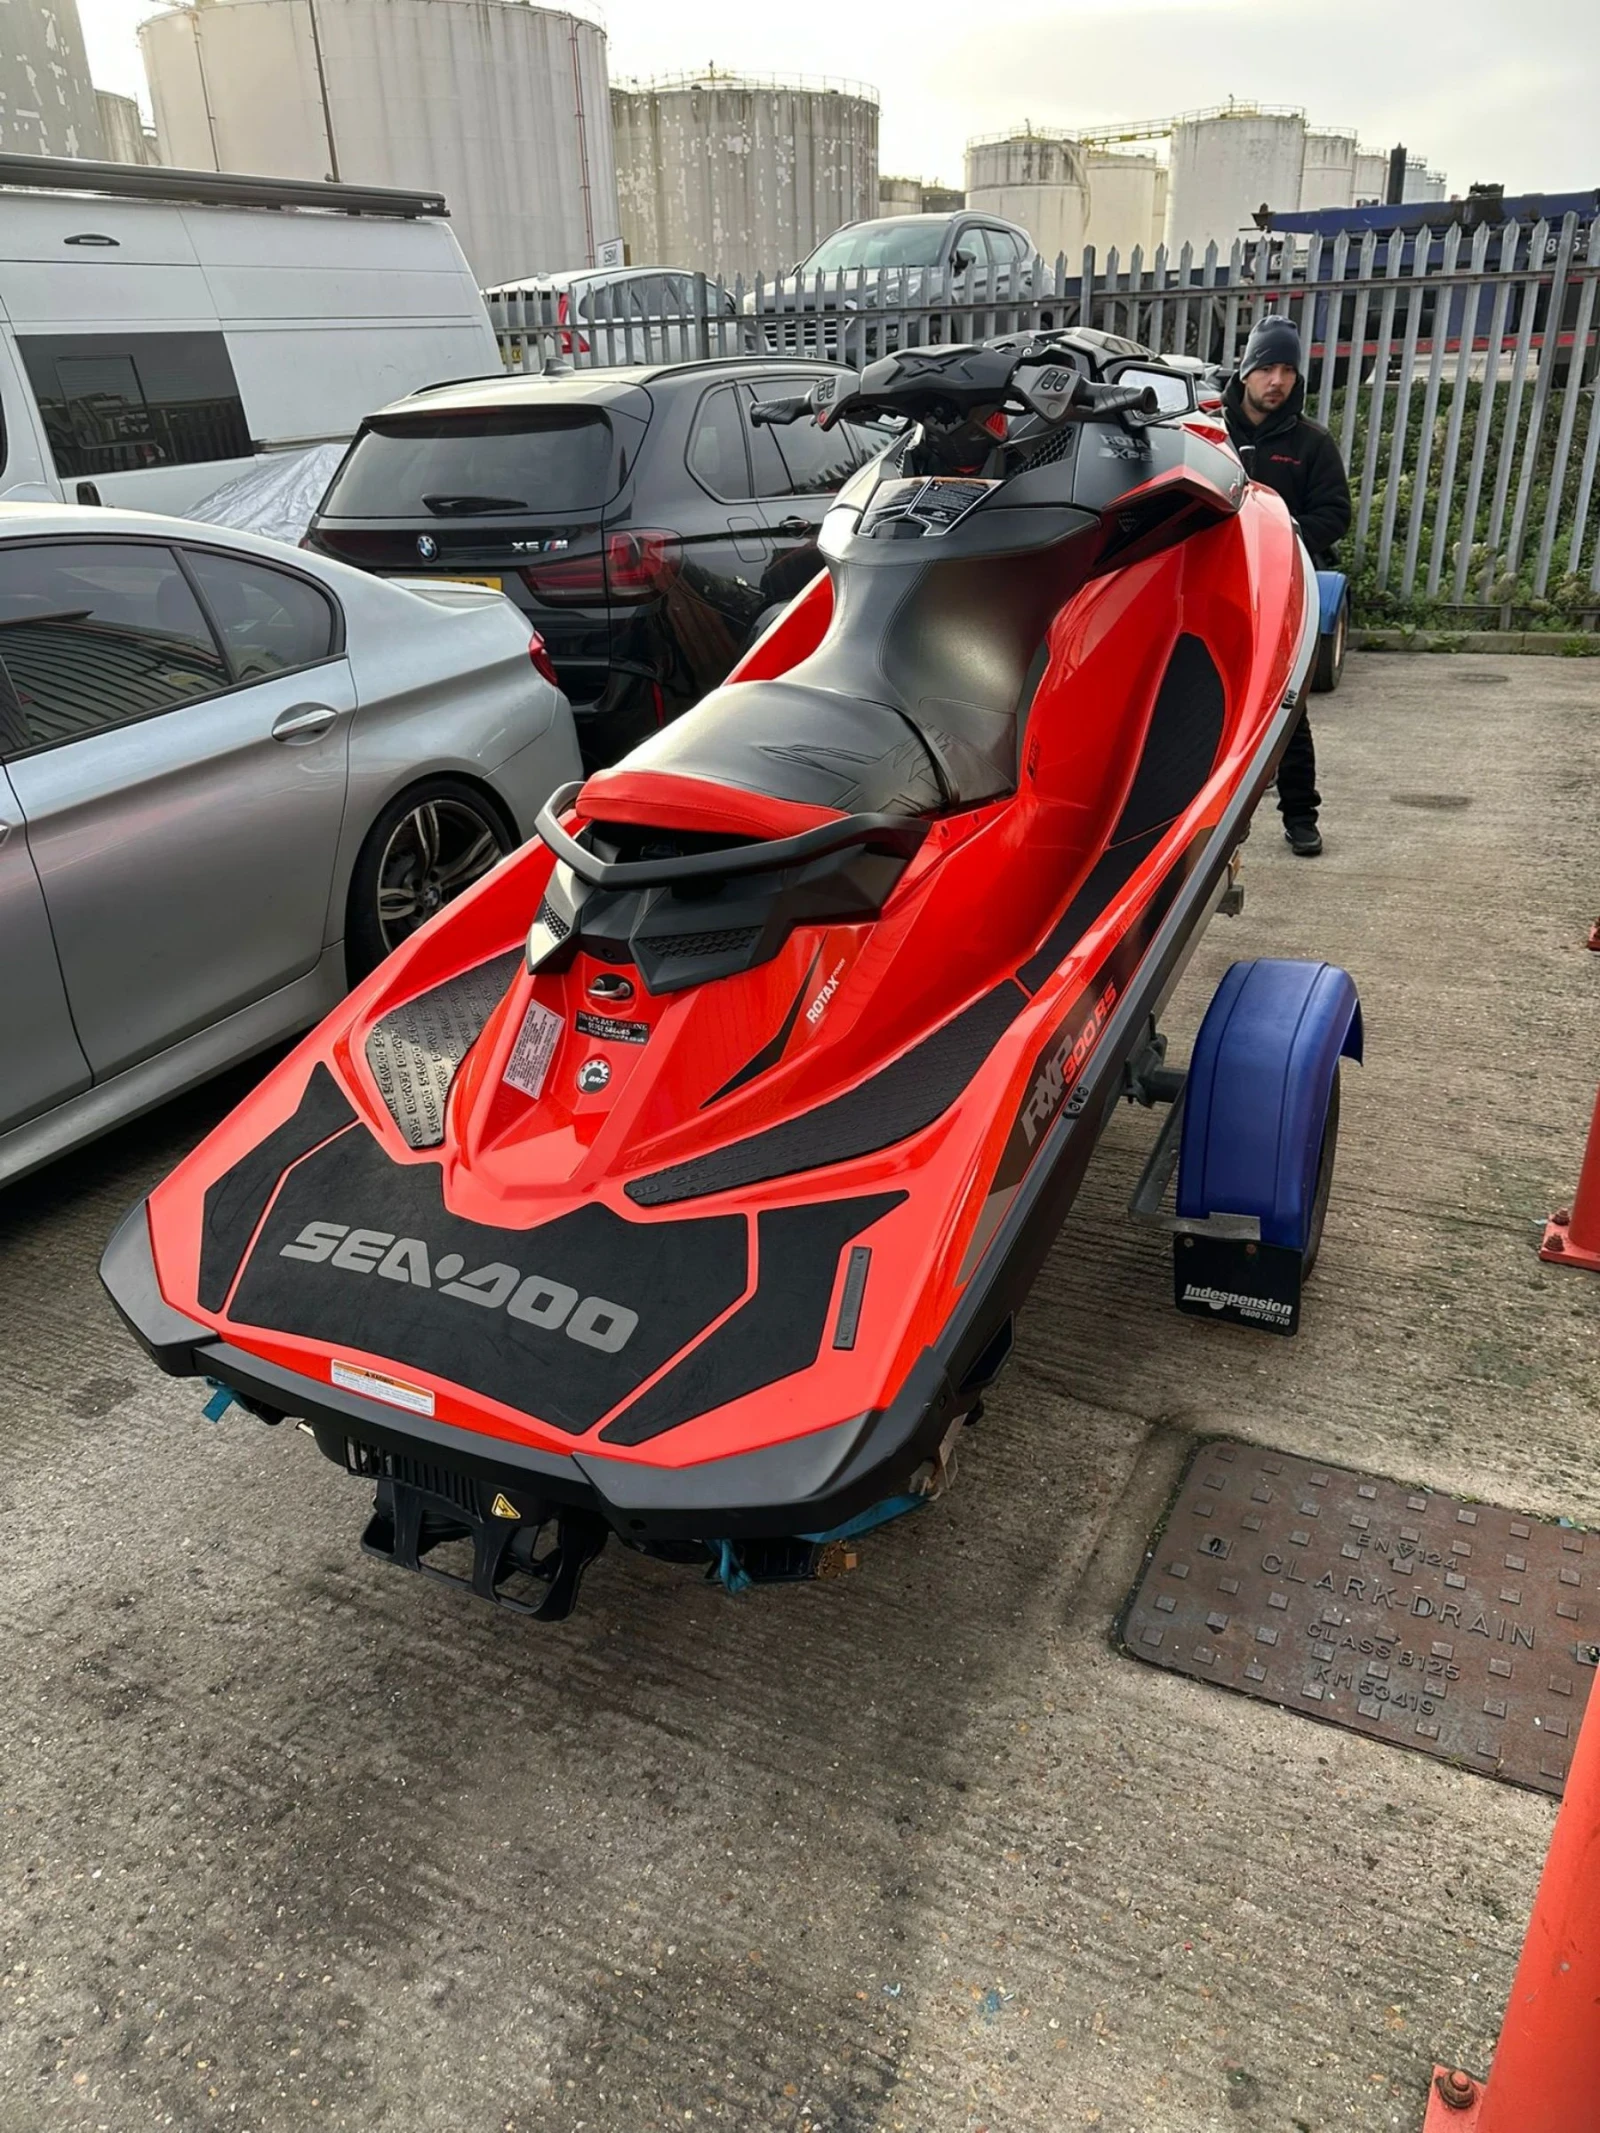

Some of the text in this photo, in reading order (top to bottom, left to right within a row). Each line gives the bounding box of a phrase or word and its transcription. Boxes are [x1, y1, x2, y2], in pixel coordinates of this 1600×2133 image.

[512, 541, 539, 552] X5
[806, 975, 839, 1023] ROTAX
[1184, 1284, 1293, 1315] Indespension
[1240, 1308, 1260, 1319] 0800
[1275, 1315, 1290, 1326] 720
[1356, 1533, 1458, 1572] EN 124
[1261, 1553, 1536, 1650] CLARK-DRAIN
[1307, 1622, 1461, 1681] CLASS B125
[1314, 1665, 1436, 1716] KM 53419
